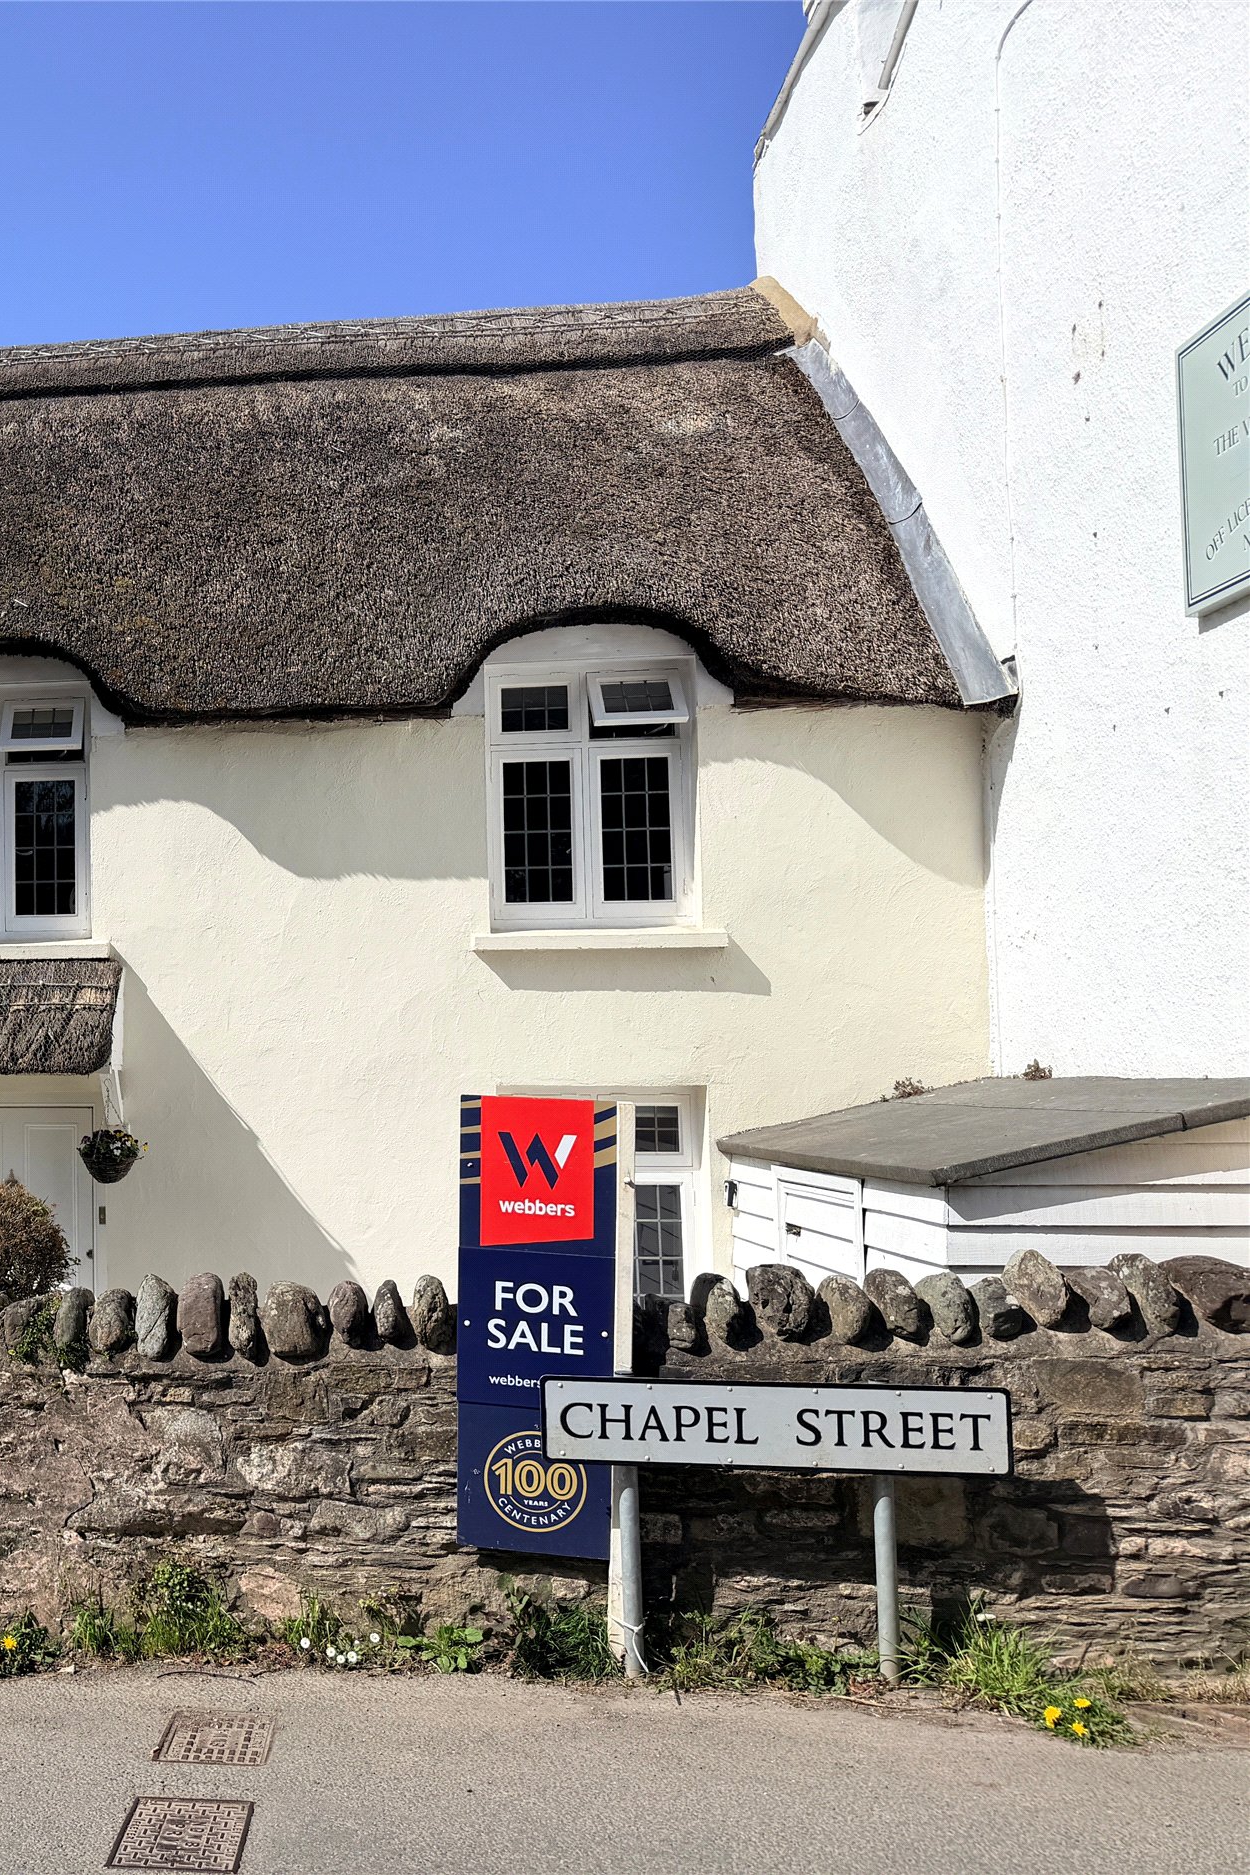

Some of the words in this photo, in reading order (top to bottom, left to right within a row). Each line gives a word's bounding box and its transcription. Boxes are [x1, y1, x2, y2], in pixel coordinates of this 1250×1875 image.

[1232, 375, 1249, 396] TO
[1213, 425, 1240, 456] THE
[1205, 525, 1225, 561] OFF
[499, 1199, 575, 1217] webbers
[495, 1280, 579, 1317] FOR
[487, 1318, 584, 1356] SALE
[559, 1401, 760, 1446] CHAPEL
[795, 1407, 993, 1452] STREET
[504, 1438, 541, 1455] WEBB
[491, 1458, 578, 1501] 100
[498, 1497, 571, 1525] CENTENARY
[523, 1499, 549, 1507] YEARS
